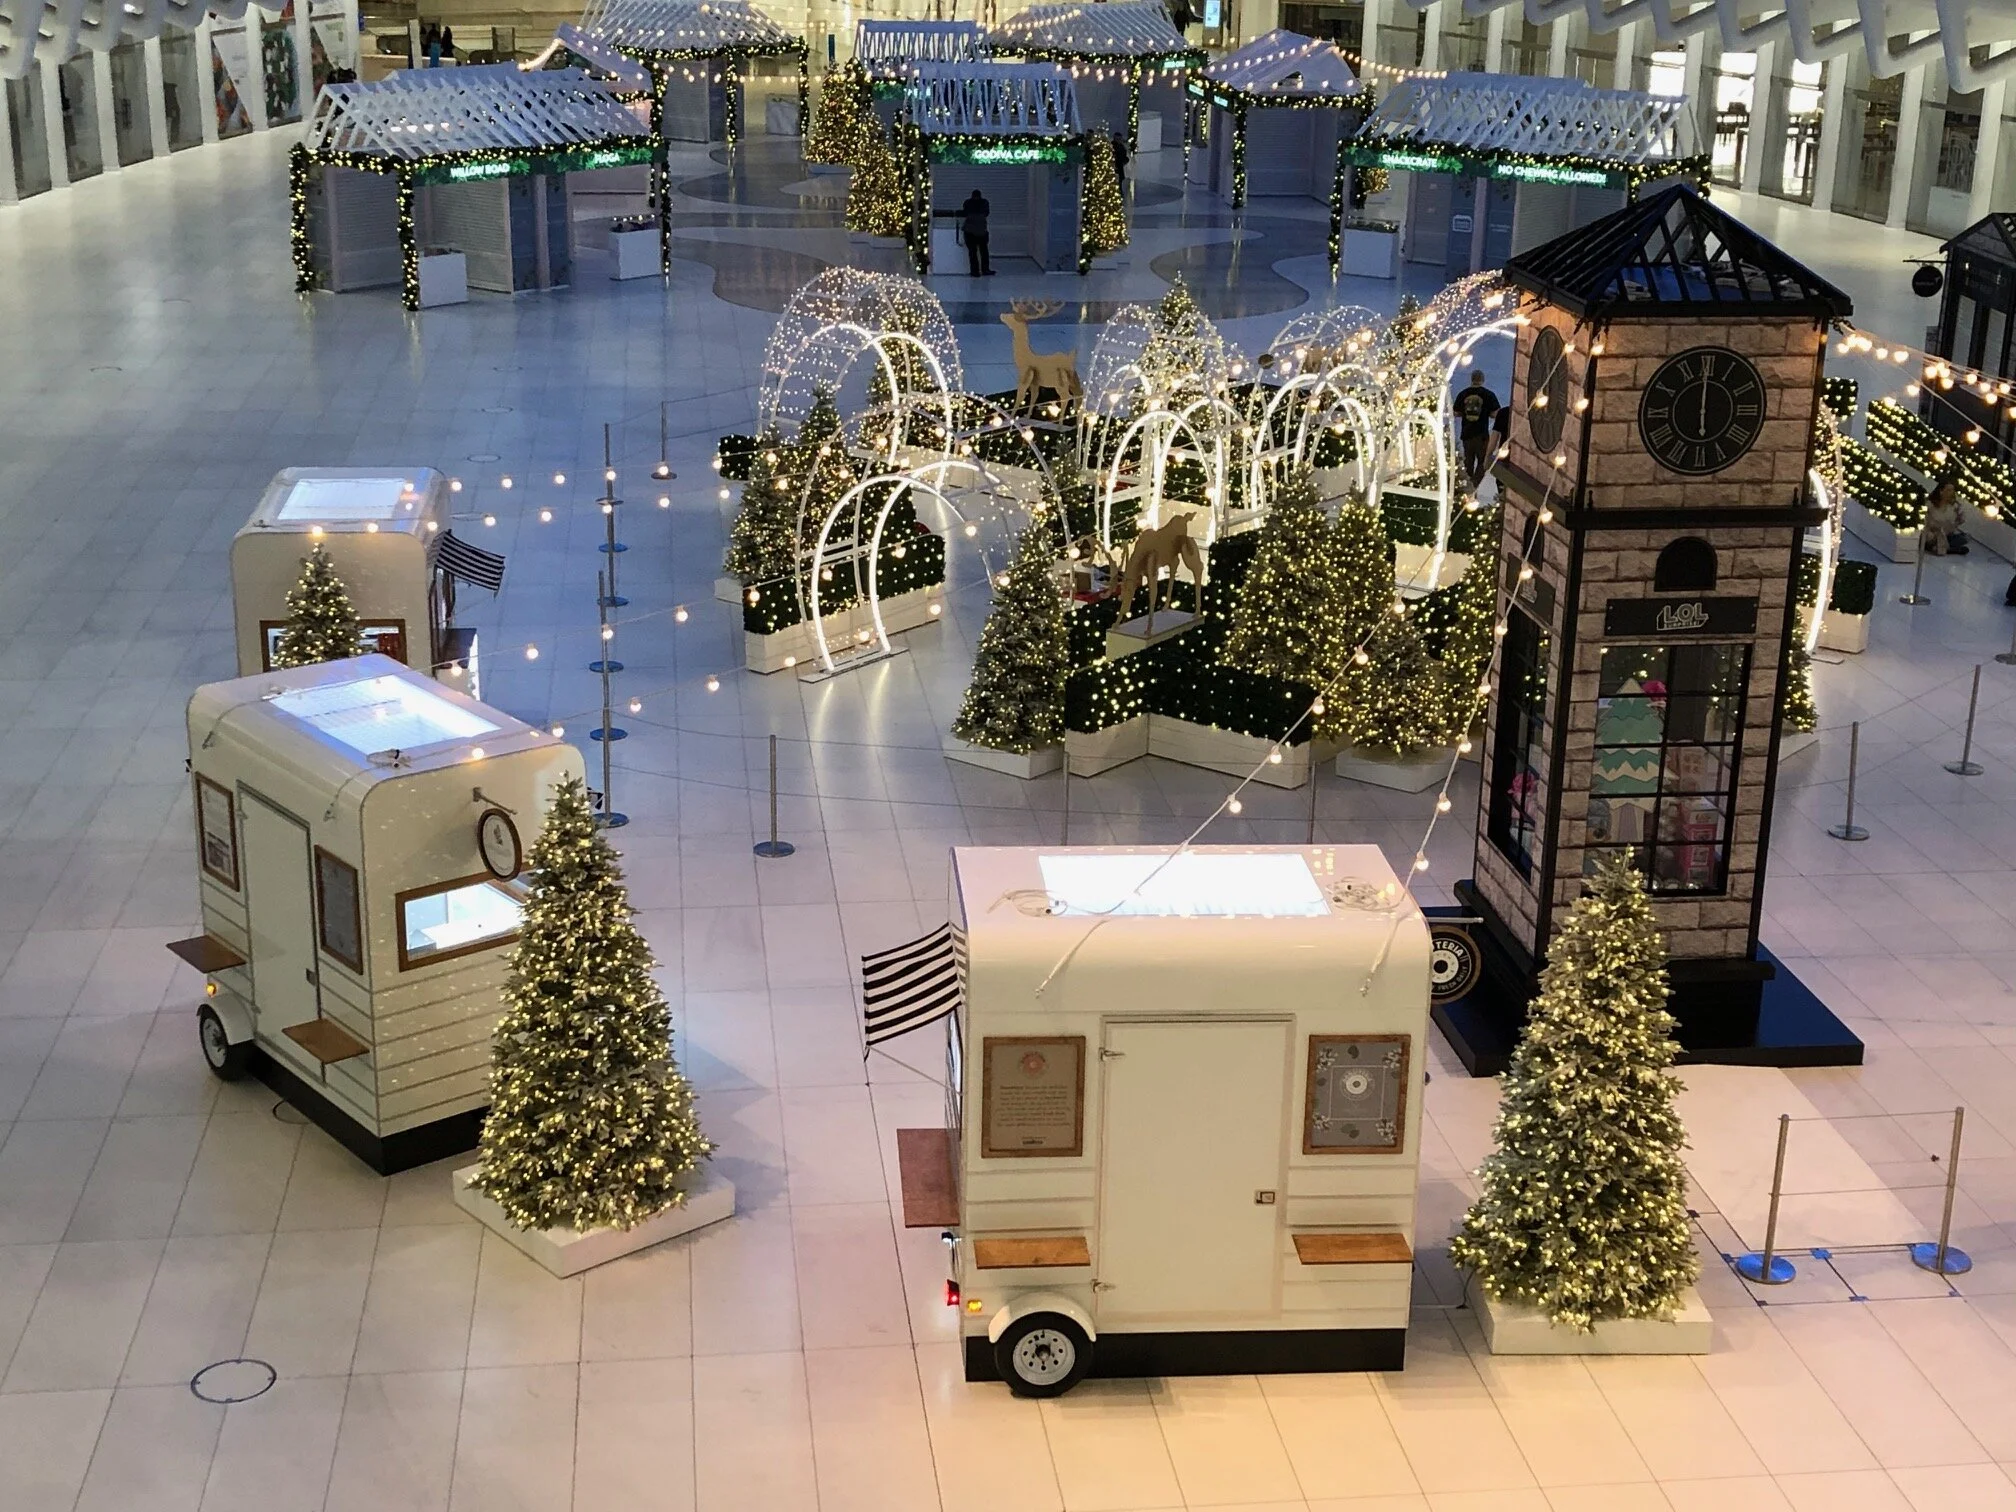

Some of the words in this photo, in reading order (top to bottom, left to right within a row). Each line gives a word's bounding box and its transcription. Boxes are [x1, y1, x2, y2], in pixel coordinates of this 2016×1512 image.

[974, 149, 1013, 160] GODIVA
[1014, 149, 1040, 160] CAFE
[450, 166, 484, 179] WILLOW
[485, 162, 511, 175] ROAD
[1498, 164, 1514, 176] NO
[1514, 166, 1559, 179] CHEWING
[1431, 941, 1465, 958] TERIA
